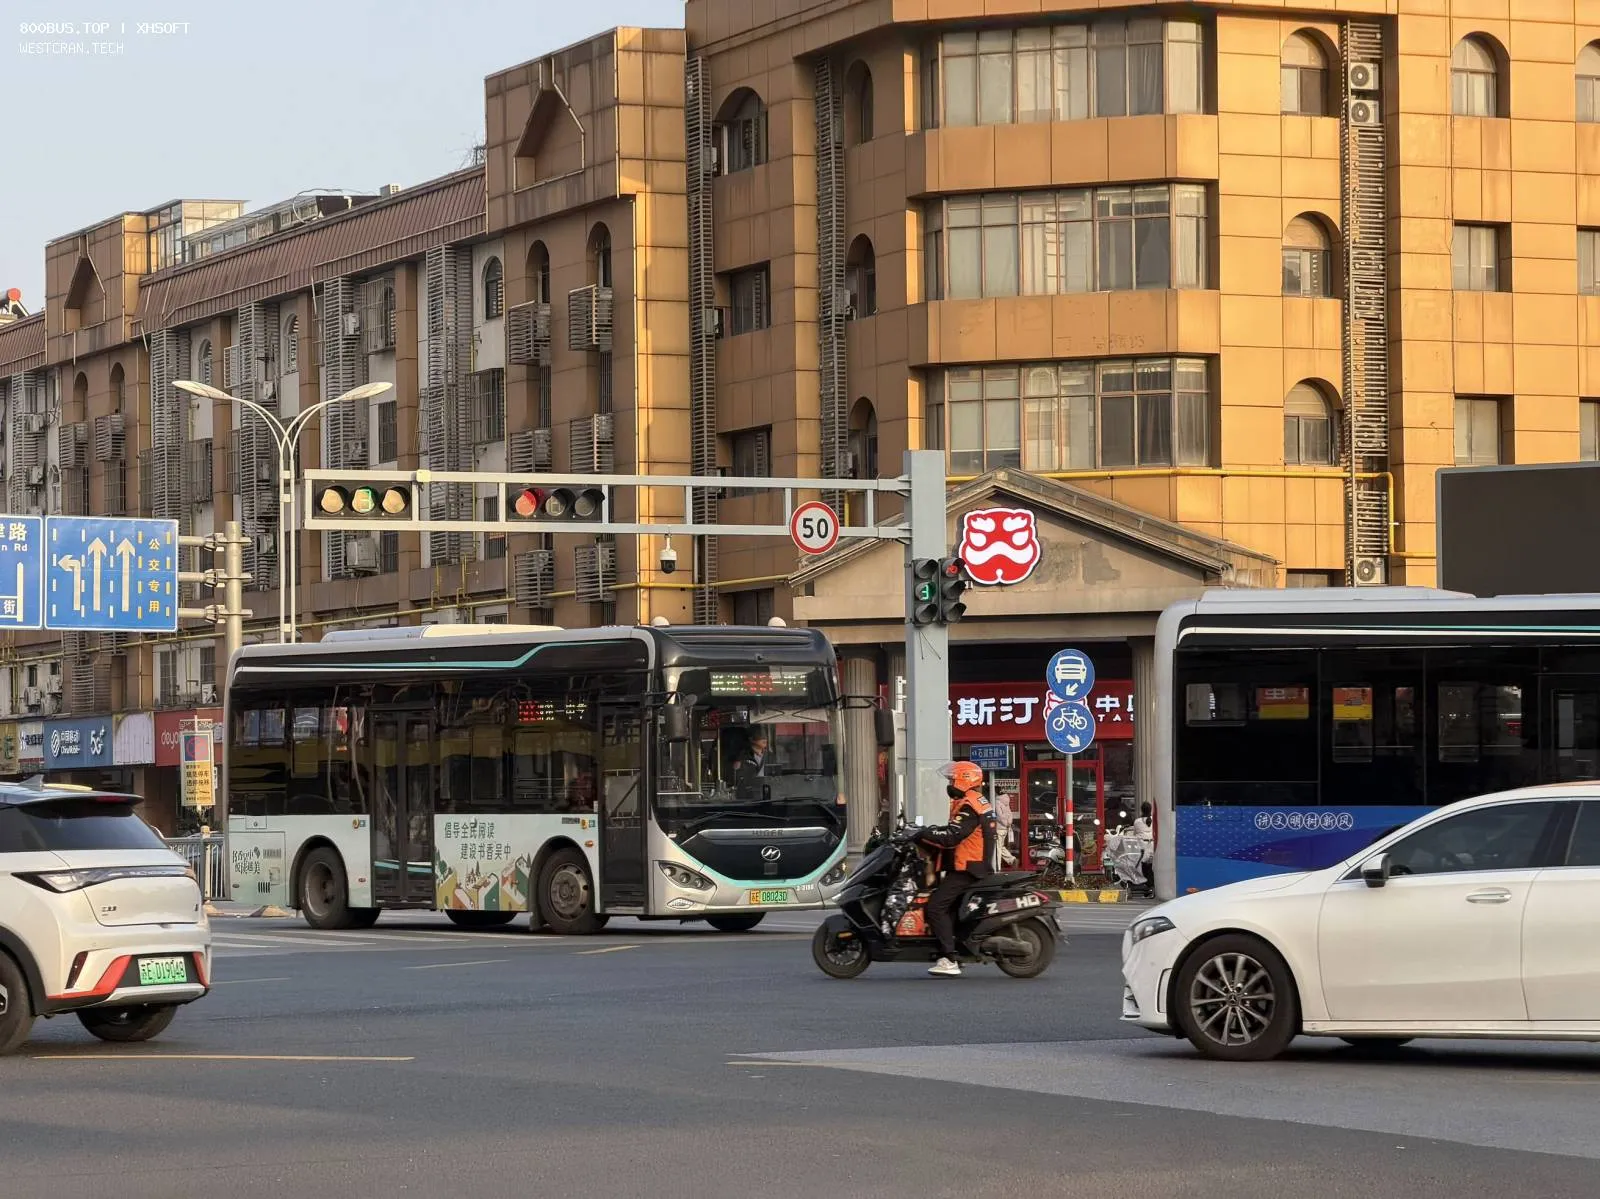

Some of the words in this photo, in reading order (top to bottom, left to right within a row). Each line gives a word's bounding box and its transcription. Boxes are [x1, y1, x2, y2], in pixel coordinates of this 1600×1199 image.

[803, 518, 829, 539] 50
[14, 543, 28, 551] Rd
[148, 538, 161, 613] 公交专用
[948, 697, 1039, 726] 斯汀
[1095, 694, 1134, 713] 中
[1256, 812, 1353, 830] 讲文明树新风
[444, 822, 495, 840] 倡导全民阅读
[460, 843, 512, 860] 建设书香吴中
